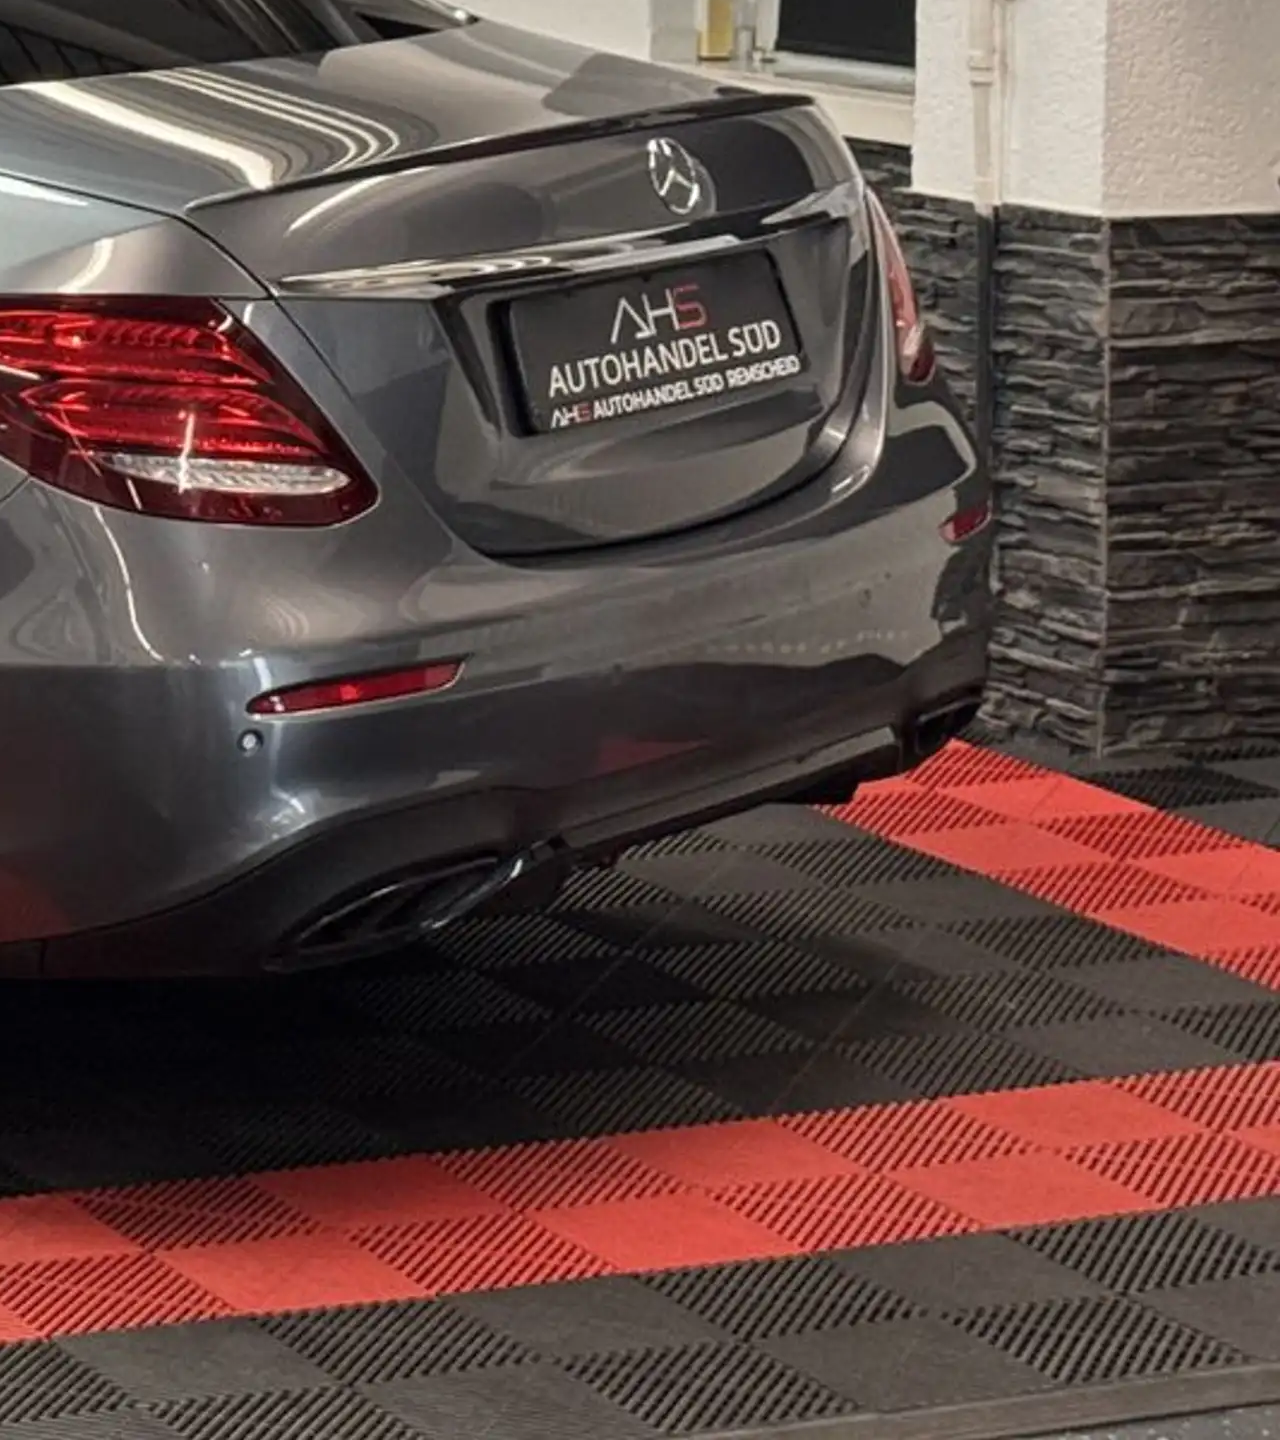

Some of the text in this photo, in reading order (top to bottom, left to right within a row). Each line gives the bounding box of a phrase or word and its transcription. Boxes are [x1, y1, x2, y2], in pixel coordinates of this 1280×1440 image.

[610, 283, 708, 344] AHS
[549, 319, 782, 398] AUTOHANDEL SÜD
[593, 380, 695, 419] AUTOHANDEL
